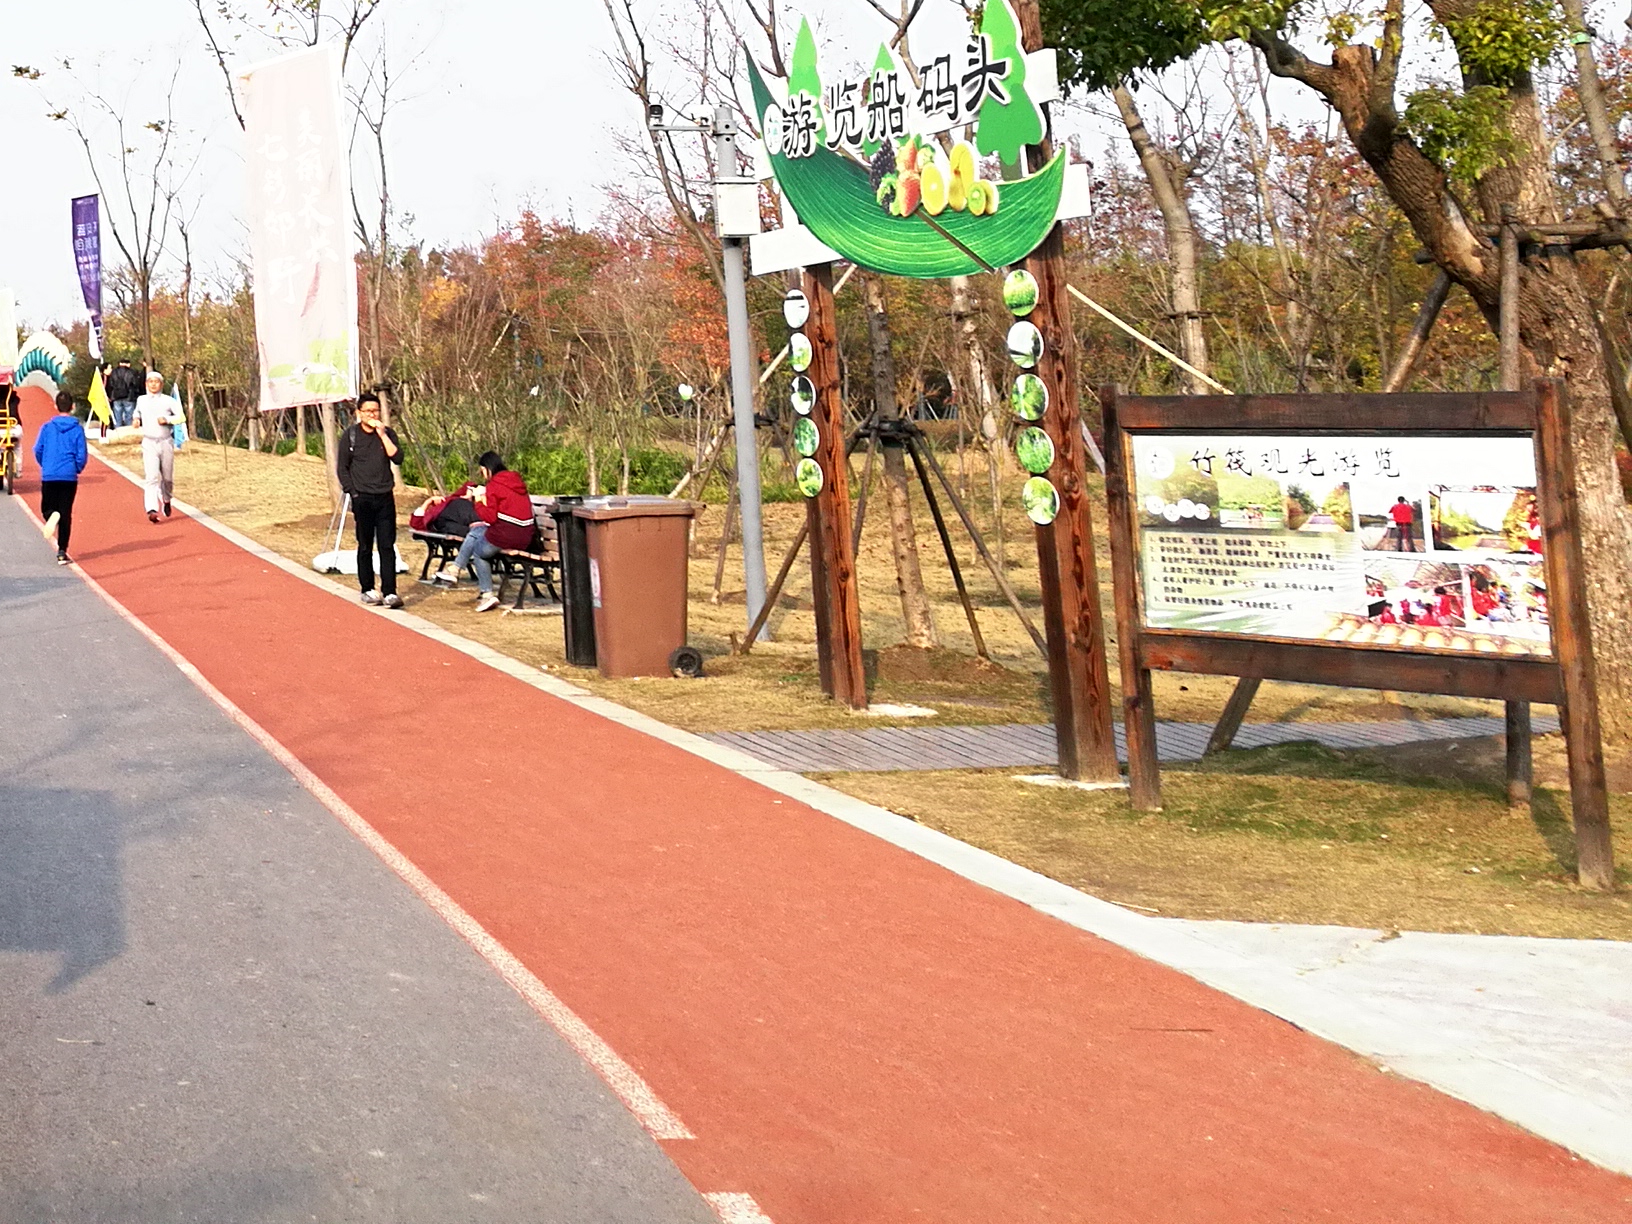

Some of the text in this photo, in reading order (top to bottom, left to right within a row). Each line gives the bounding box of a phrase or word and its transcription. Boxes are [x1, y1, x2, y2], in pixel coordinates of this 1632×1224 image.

[781, 35, 1008, 158] 游览船码头
[1188, 447, 1401, 479] 竹筏观光游览
